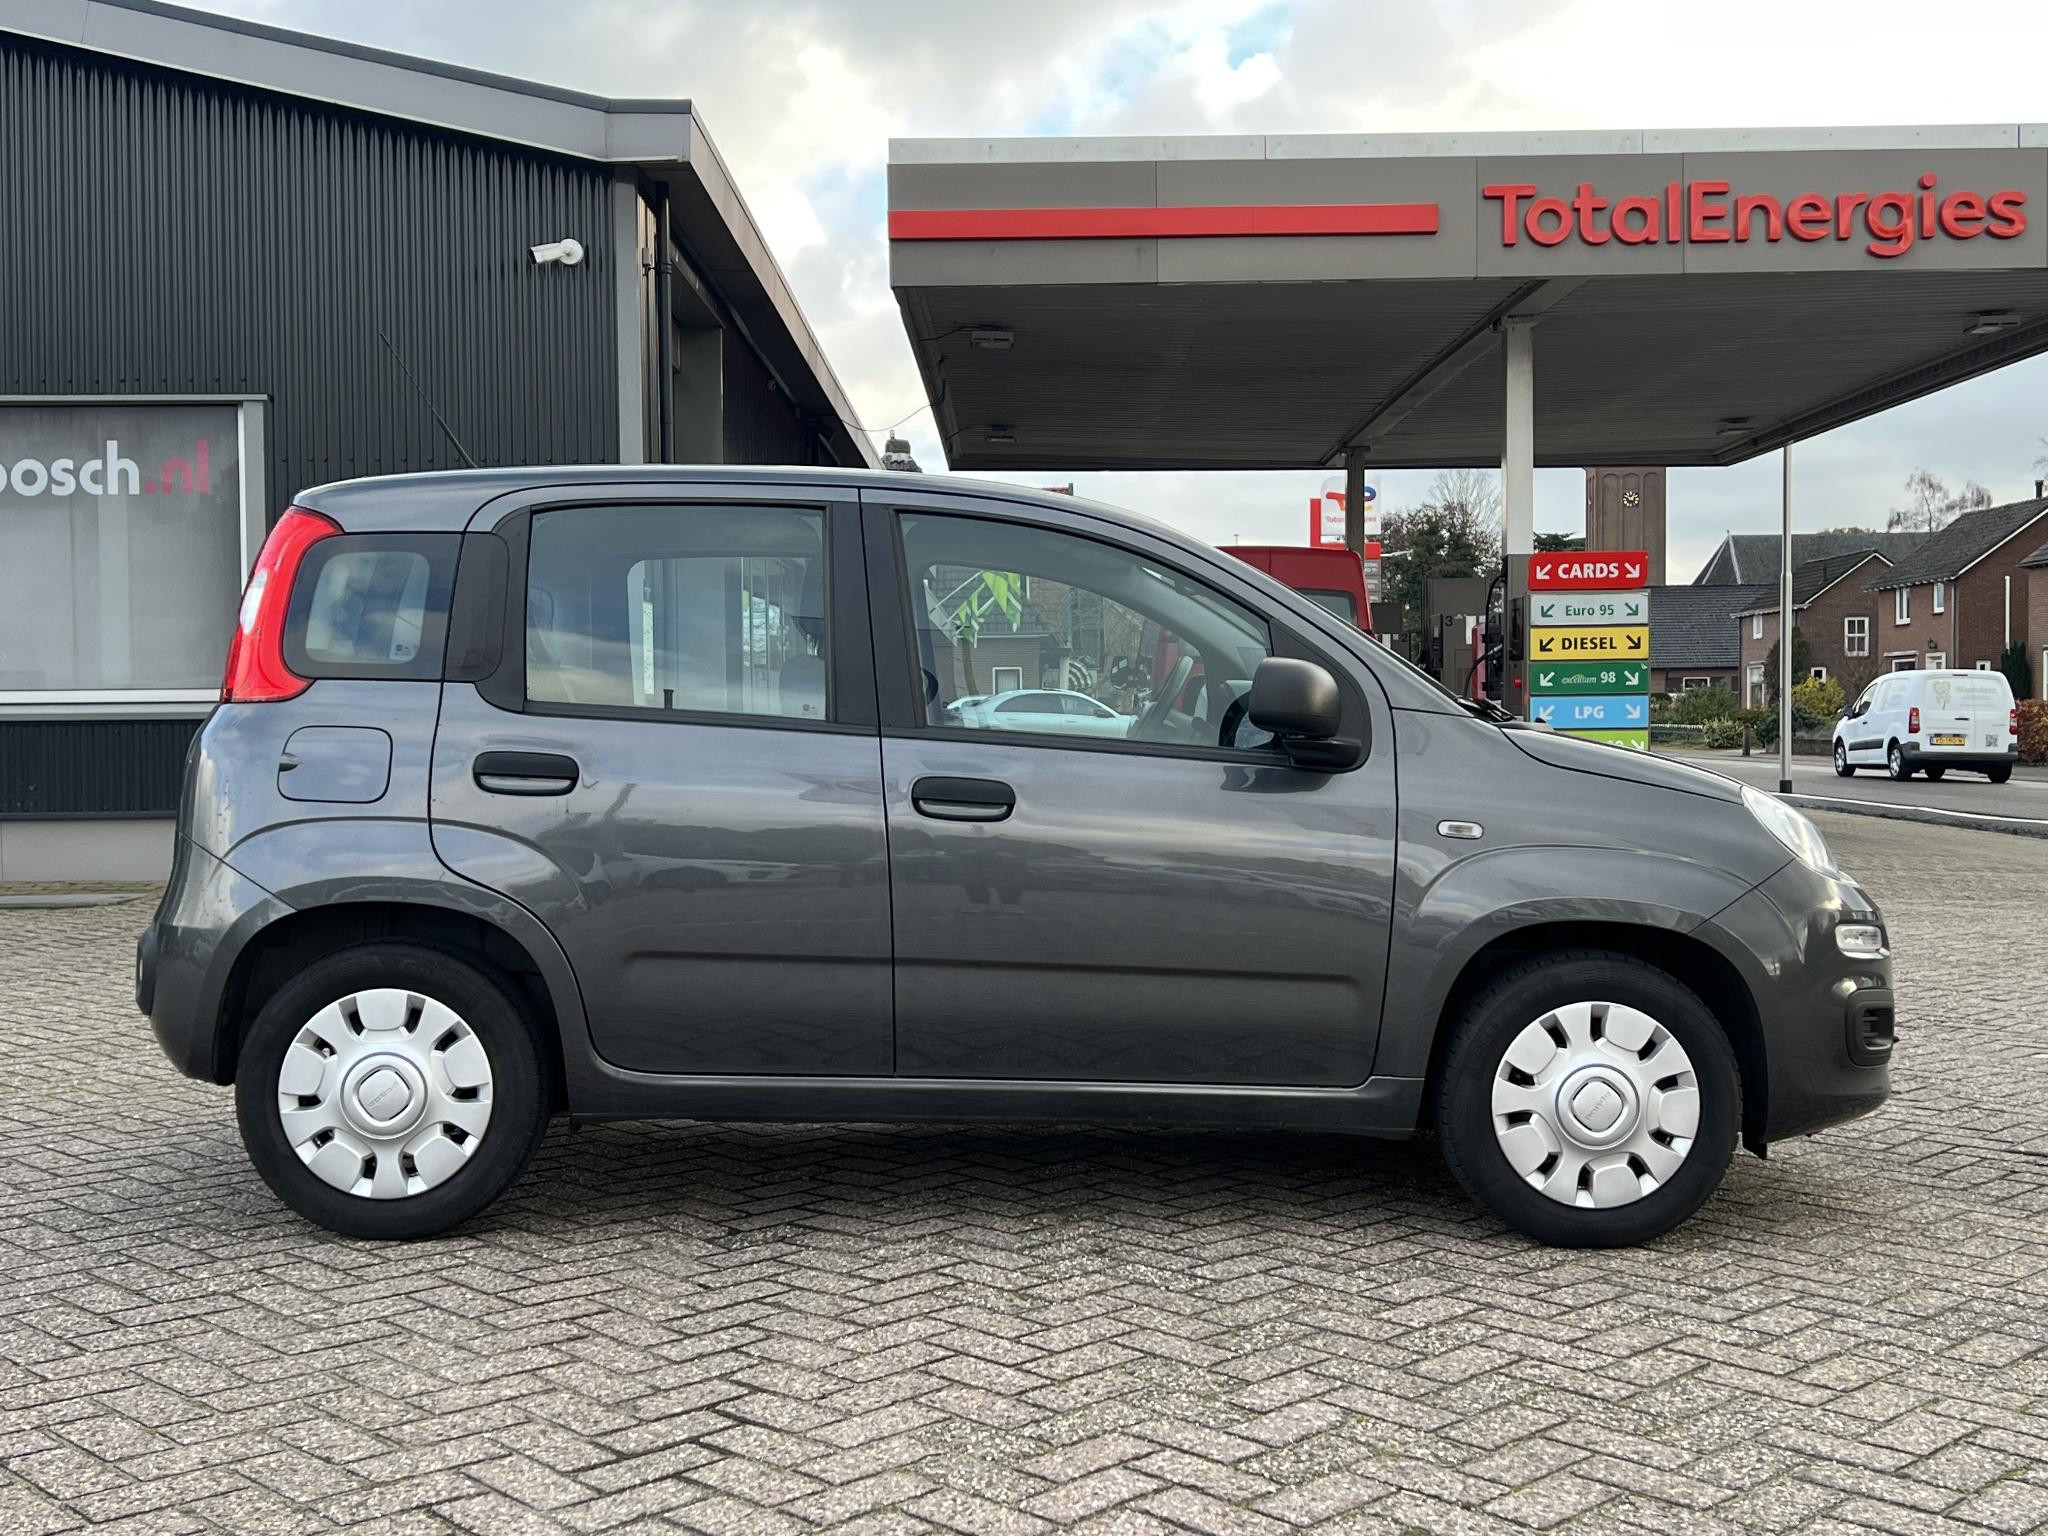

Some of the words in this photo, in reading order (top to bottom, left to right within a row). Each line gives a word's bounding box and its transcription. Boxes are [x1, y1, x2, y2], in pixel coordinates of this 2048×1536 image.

[1483, 173, 2028, 257] TotalEnergies
[0, 439, 209, 497] osch.nl
[1557, 562, 1620, 580] CARDS
[1565, 605, 1595, 617] Euro
[1599, 603, 1615, 616] 95
[1445, 615, 1453, 627] 3
[1400, 633, 1408, 643] 2
[1562, 636, 1618, 650] DIESEL
[1600, 671, 1617, 683] 98
[1574, 705, 1605, 720] LPG
